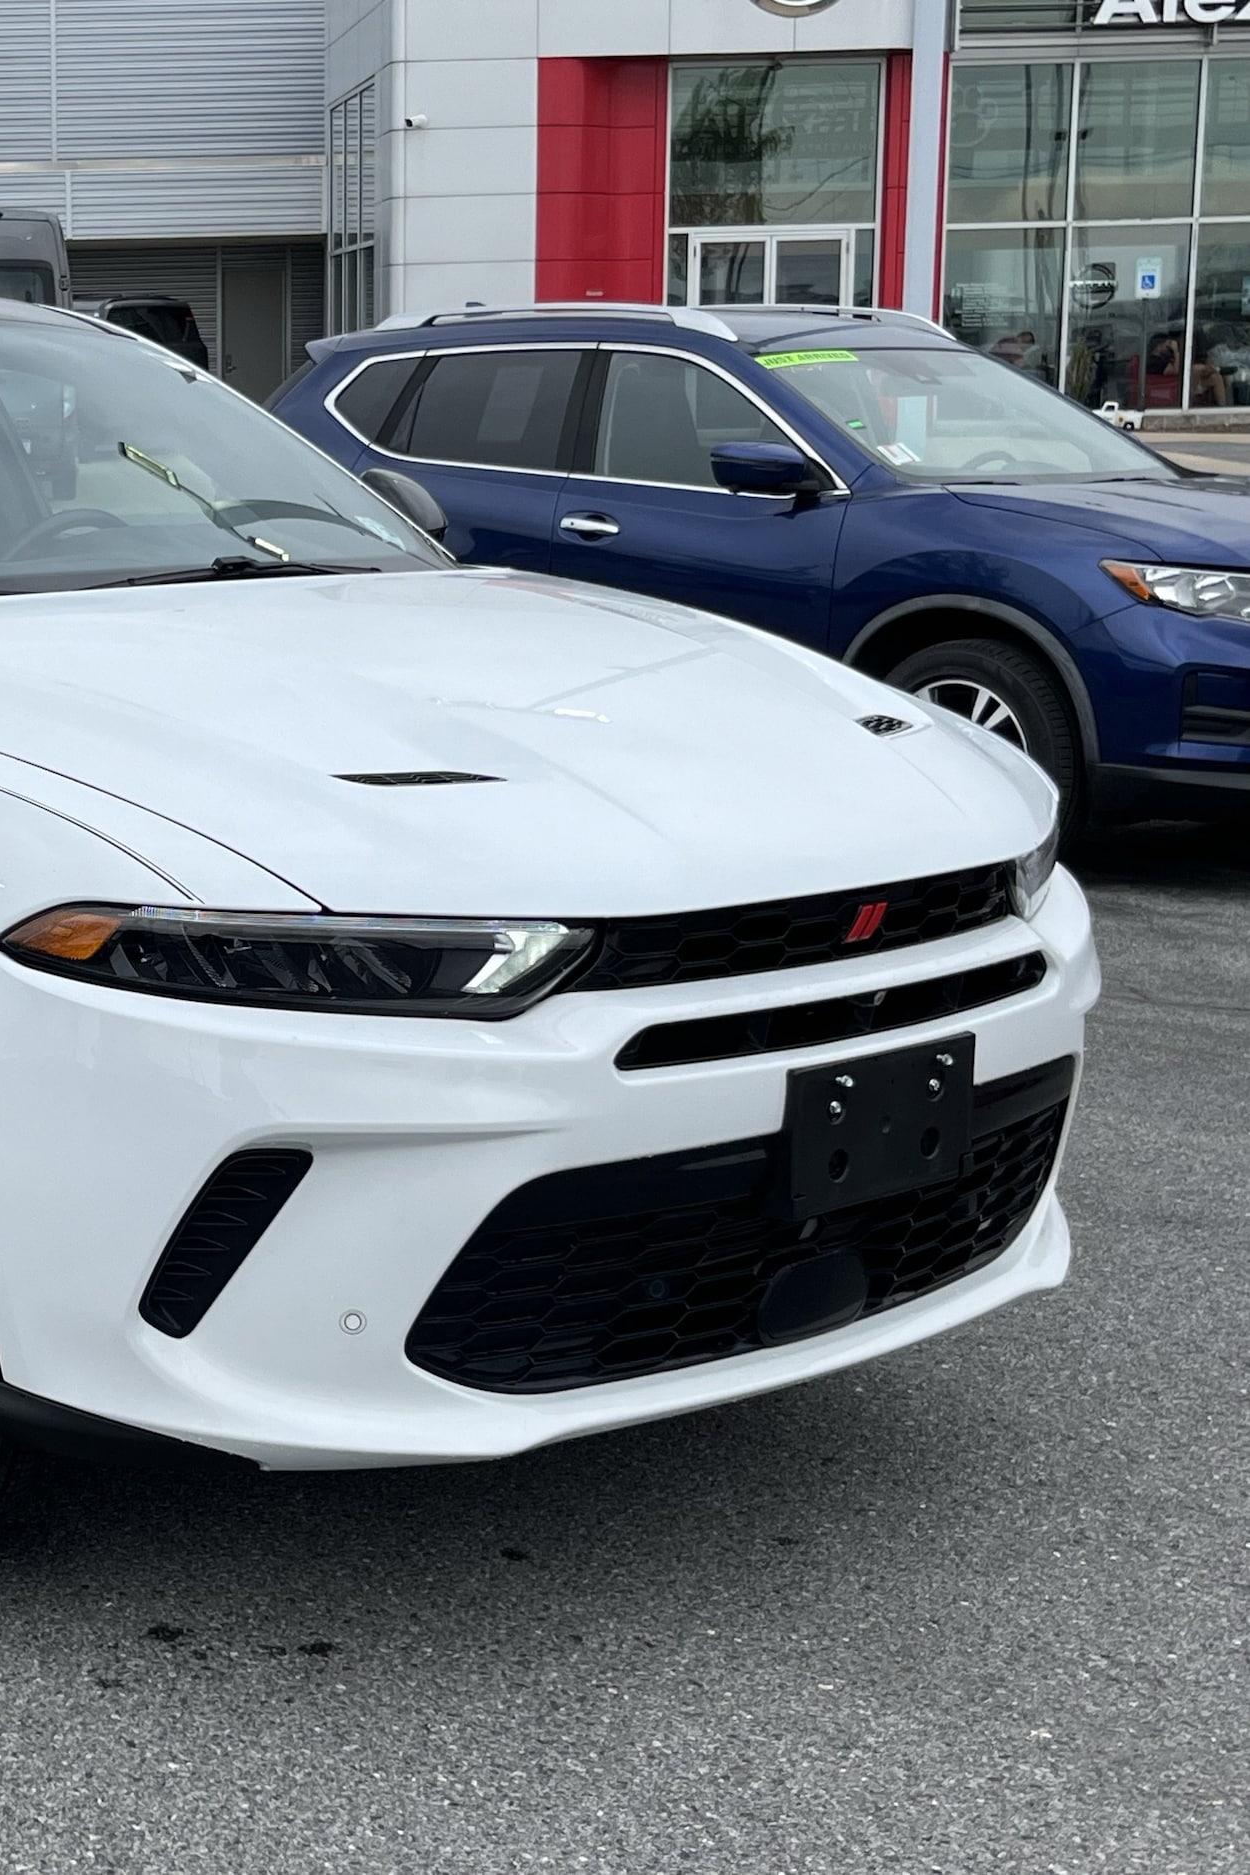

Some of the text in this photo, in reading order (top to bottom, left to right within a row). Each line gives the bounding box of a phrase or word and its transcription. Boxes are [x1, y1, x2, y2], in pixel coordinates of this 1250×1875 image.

[1092, 0, 1250, 25] Ale
[763, 352, 851, 366] JUST ARRIVED
